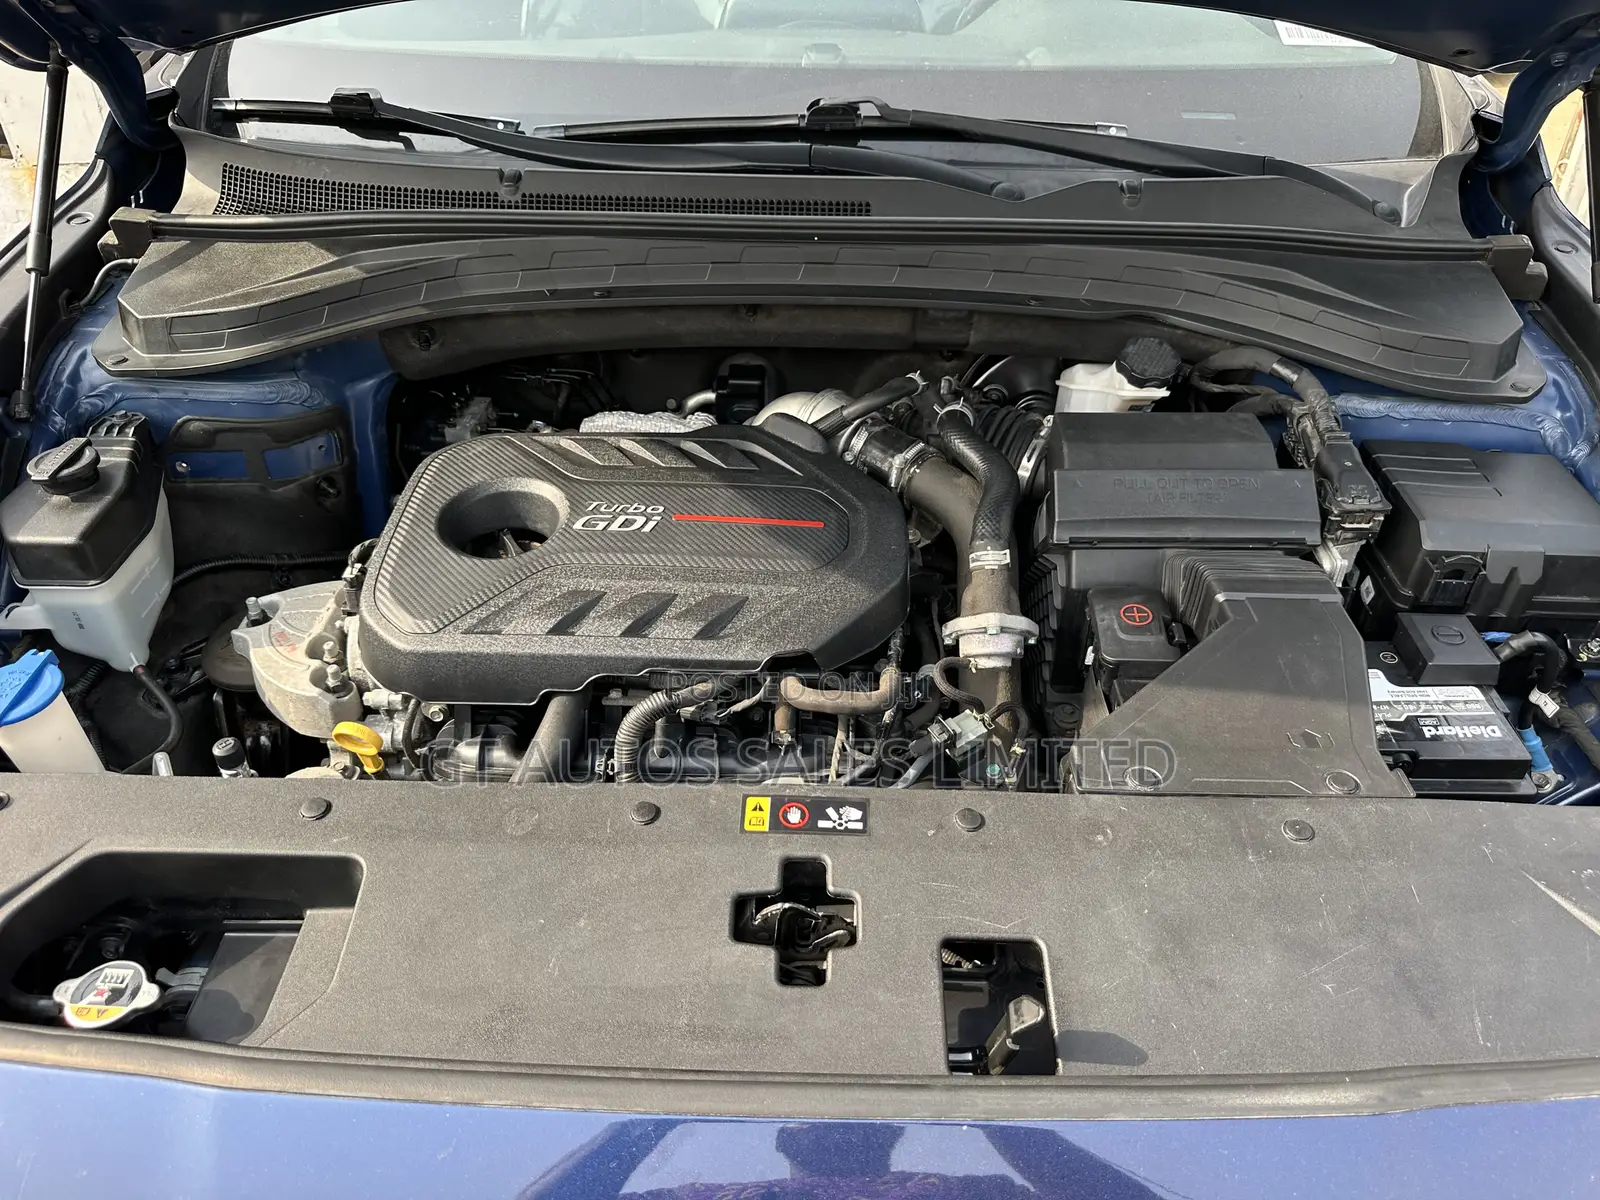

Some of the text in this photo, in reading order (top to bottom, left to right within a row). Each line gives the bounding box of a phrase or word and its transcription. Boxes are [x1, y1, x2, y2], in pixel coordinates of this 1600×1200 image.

[1113, 477, 1261, 490] PULL OUT TO OPEN
[586, 501, 665, 514] Turbo
[572, 514, 663, 533] GDi
[1421, 725, 1503, 738] DieHard
